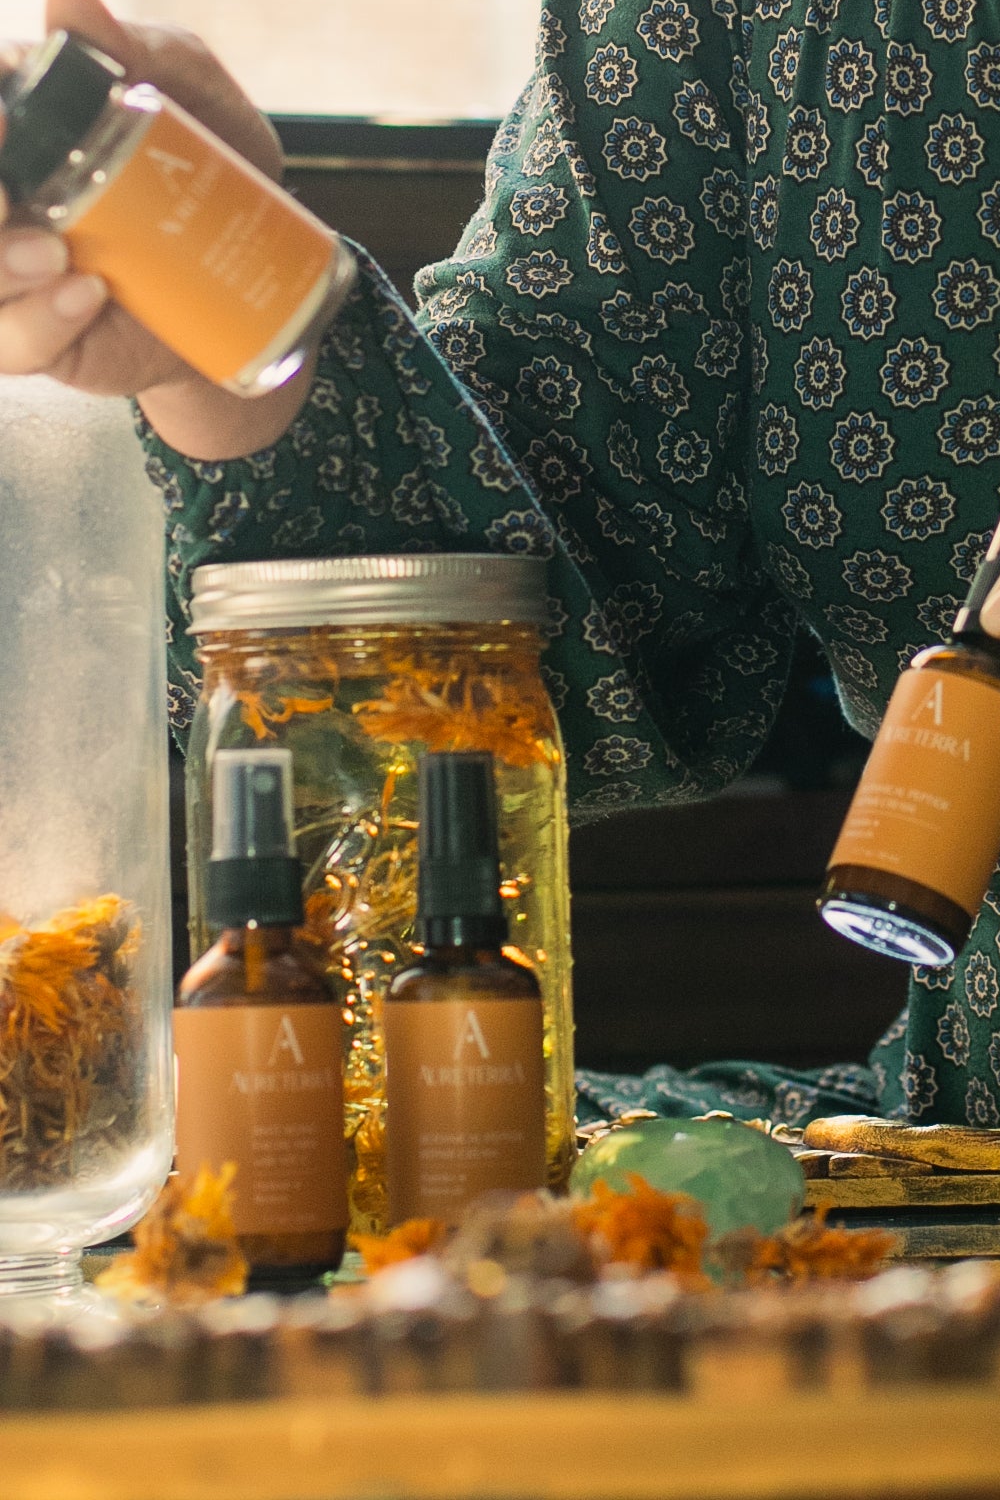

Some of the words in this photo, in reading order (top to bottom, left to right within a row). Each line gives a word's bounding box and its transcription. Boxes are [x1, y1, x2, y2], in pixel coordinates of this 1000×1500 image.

[910, 679, 944, 726] A
[267, 1014, 305, 1066] A
[453, 1009, 491, 1060] A
